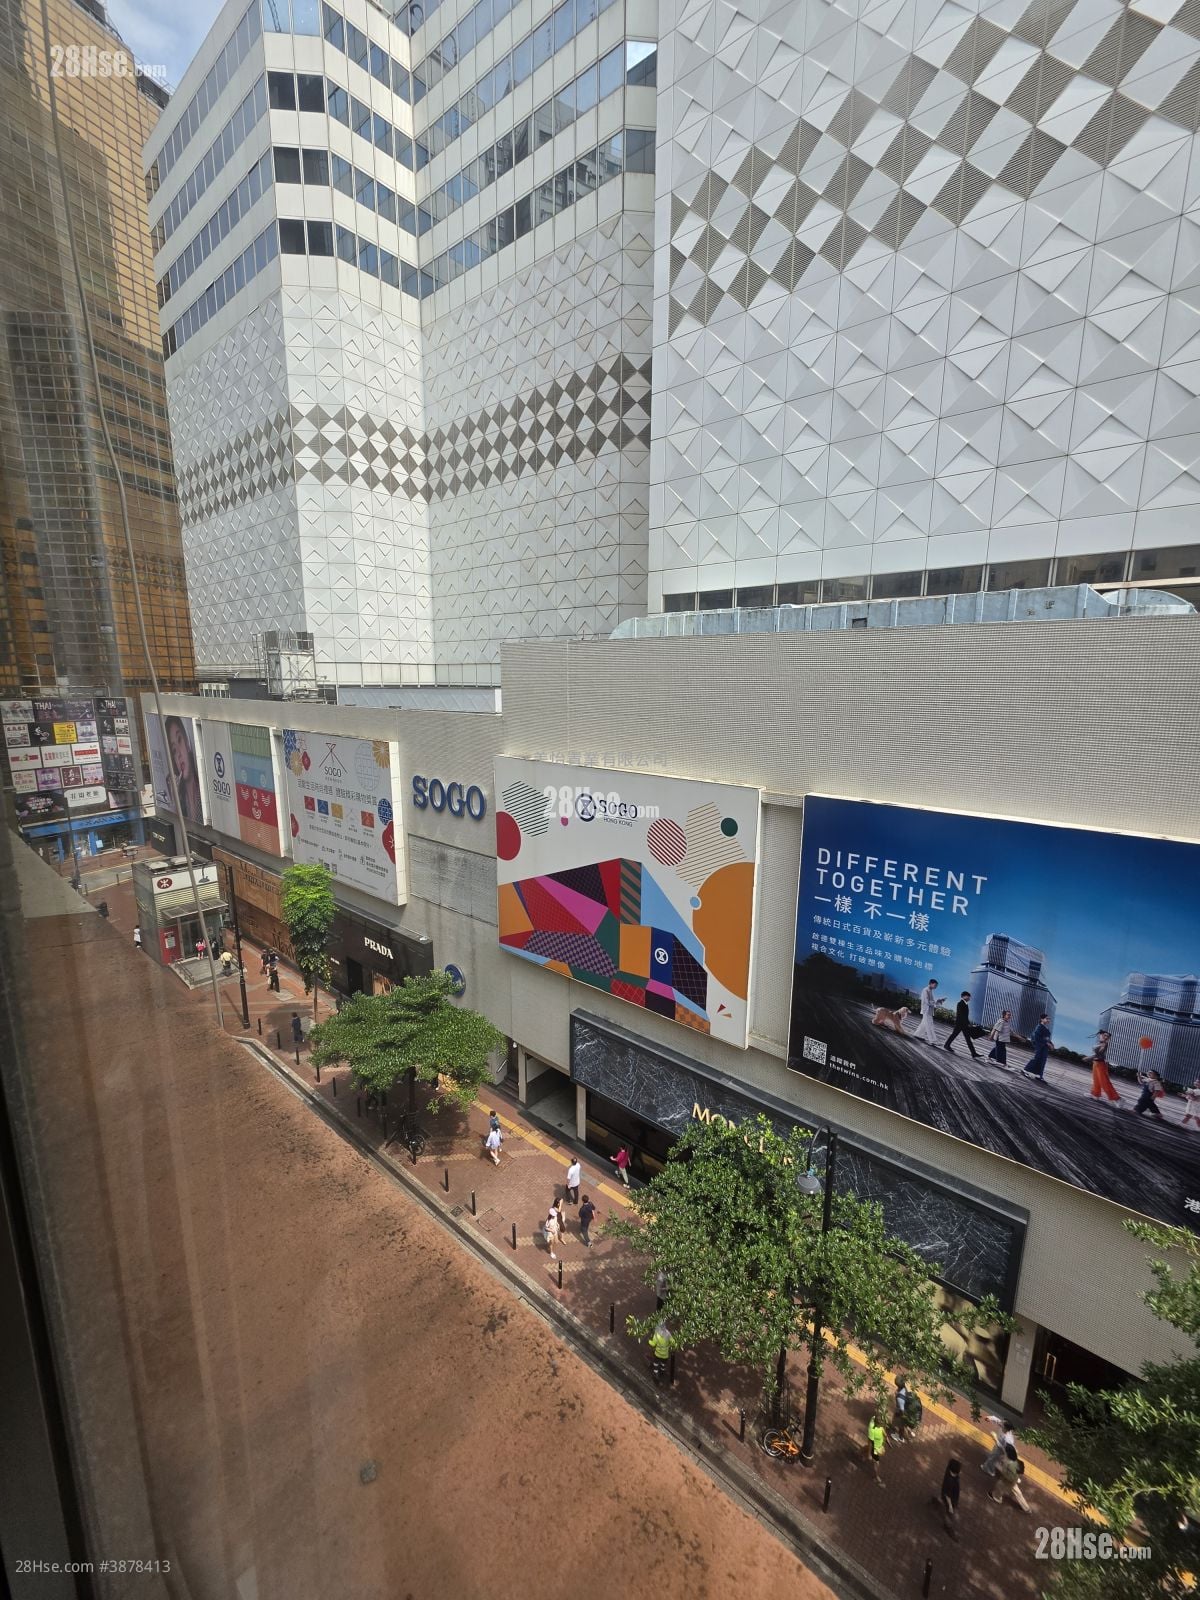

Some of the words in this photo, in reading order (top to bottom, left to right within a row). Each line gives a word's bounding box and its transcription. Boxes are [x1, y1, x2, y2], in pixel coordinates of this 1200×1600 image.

[412, 775, 487, 821] SOGO
[599, 799, 639, 819] SOGO
[603, 817, 618, 825] HONG
[618, 819, 633, 828] KONG
[818, 847, 988, 895] DIFFERENT
[816, 868, 969, 917] TOGETHER
[814, 894, 853, 915] 一樣
[863, 901, 931, 933] 不一樣
[364, 936, 394, 960] PRADA
[830, 1063, 889, 1091] thetwins.com.hk
